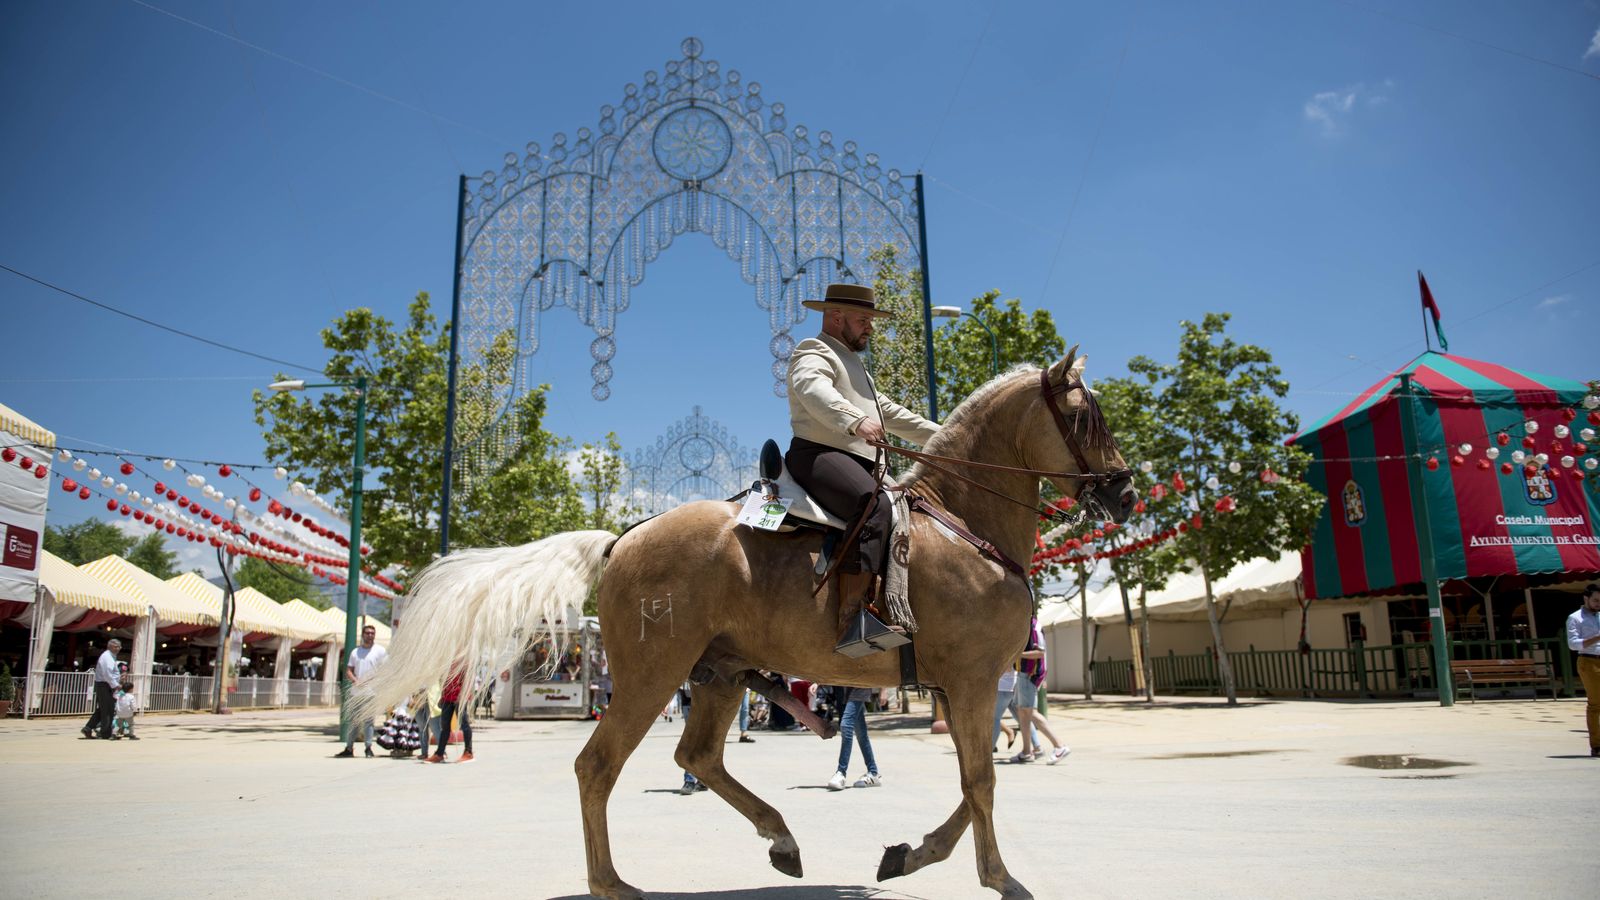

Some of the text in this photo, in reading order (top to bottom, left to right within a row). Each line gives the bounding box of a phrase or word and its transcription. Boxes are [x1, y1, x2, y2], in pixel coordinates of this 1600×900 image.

[1496, 515, 1584, 526] Caseta Municipal
[1470, 535, 1554, 547] AYUNTAMIENTO
[1557, 536, 1570, 545] DE
